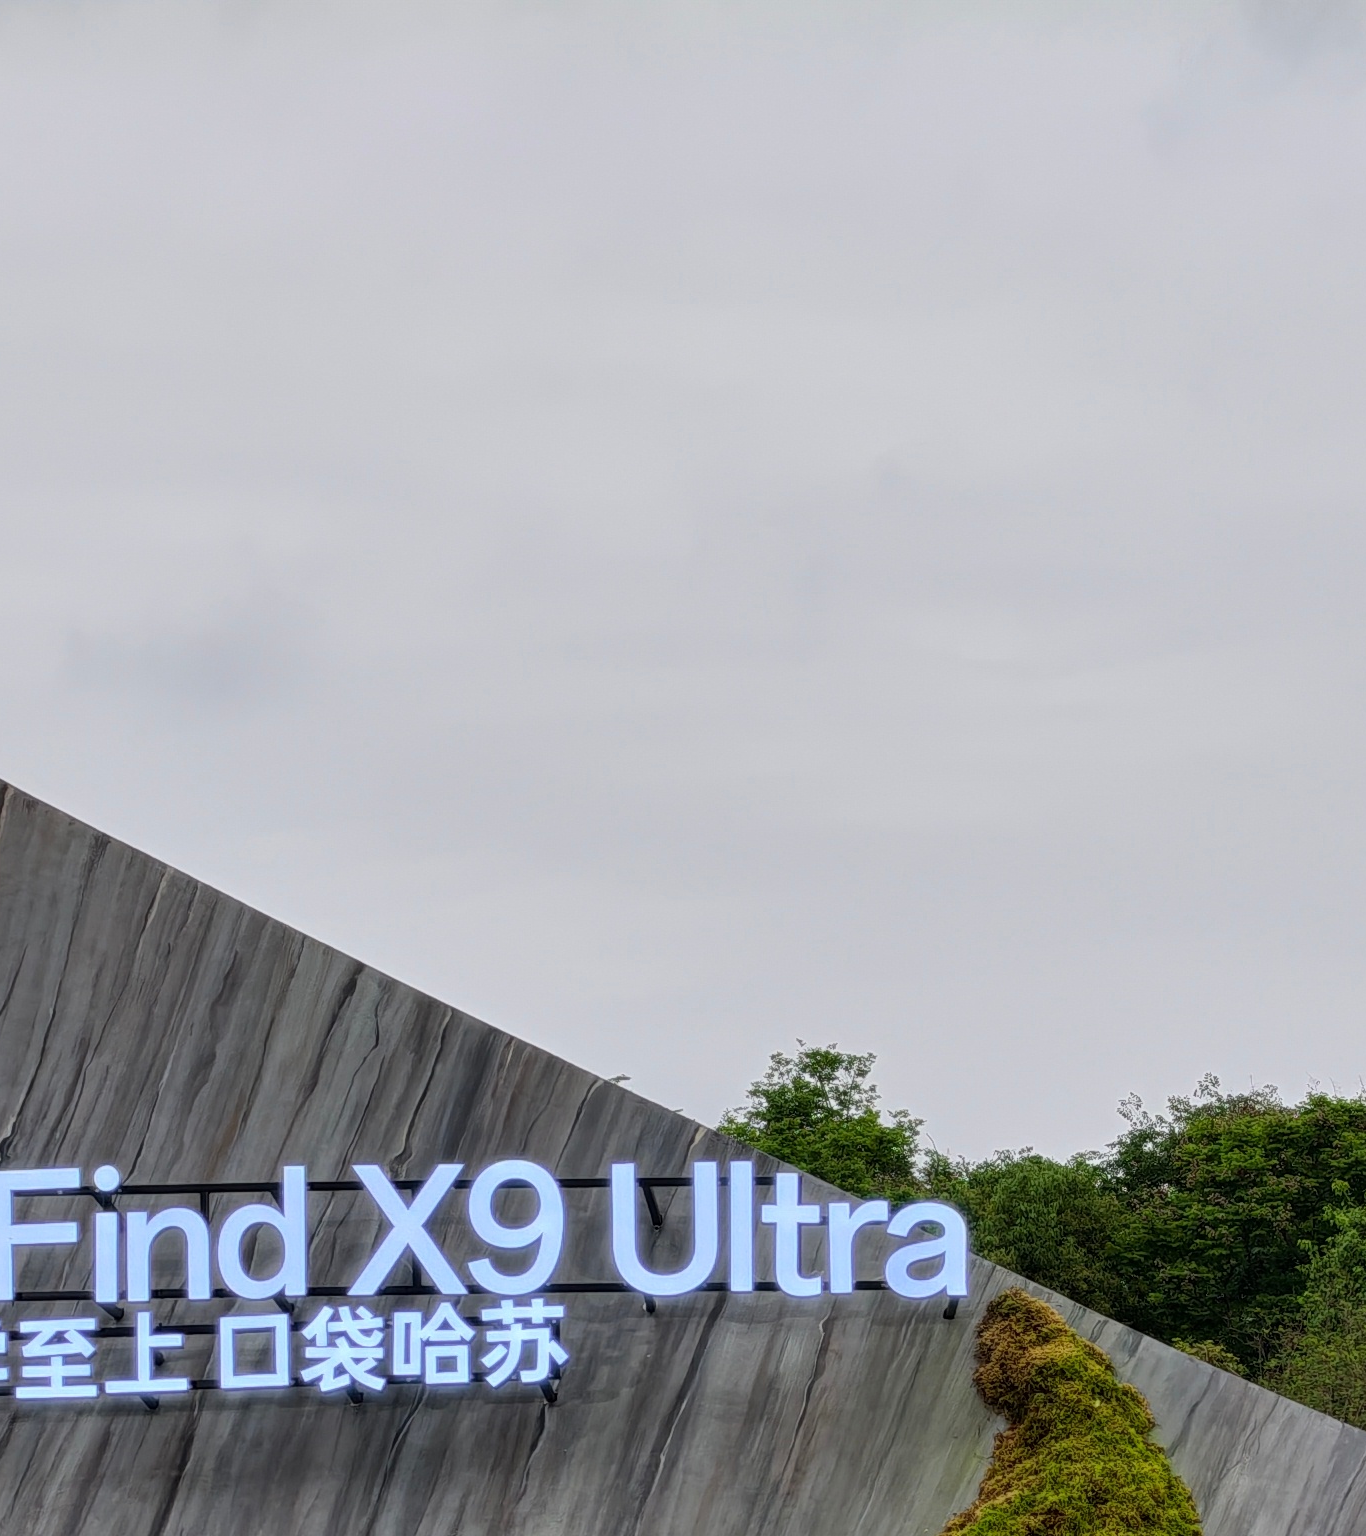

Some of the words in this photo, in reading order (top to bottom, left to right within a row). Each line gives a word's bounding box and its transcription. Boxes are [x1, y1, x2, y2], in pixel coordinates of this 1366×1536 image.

[348, 1160, 566, 1296] X9
[611, 1160, 970, 1299] Ultra
[217, 1297, 570, 1393] 口袋哈苏
